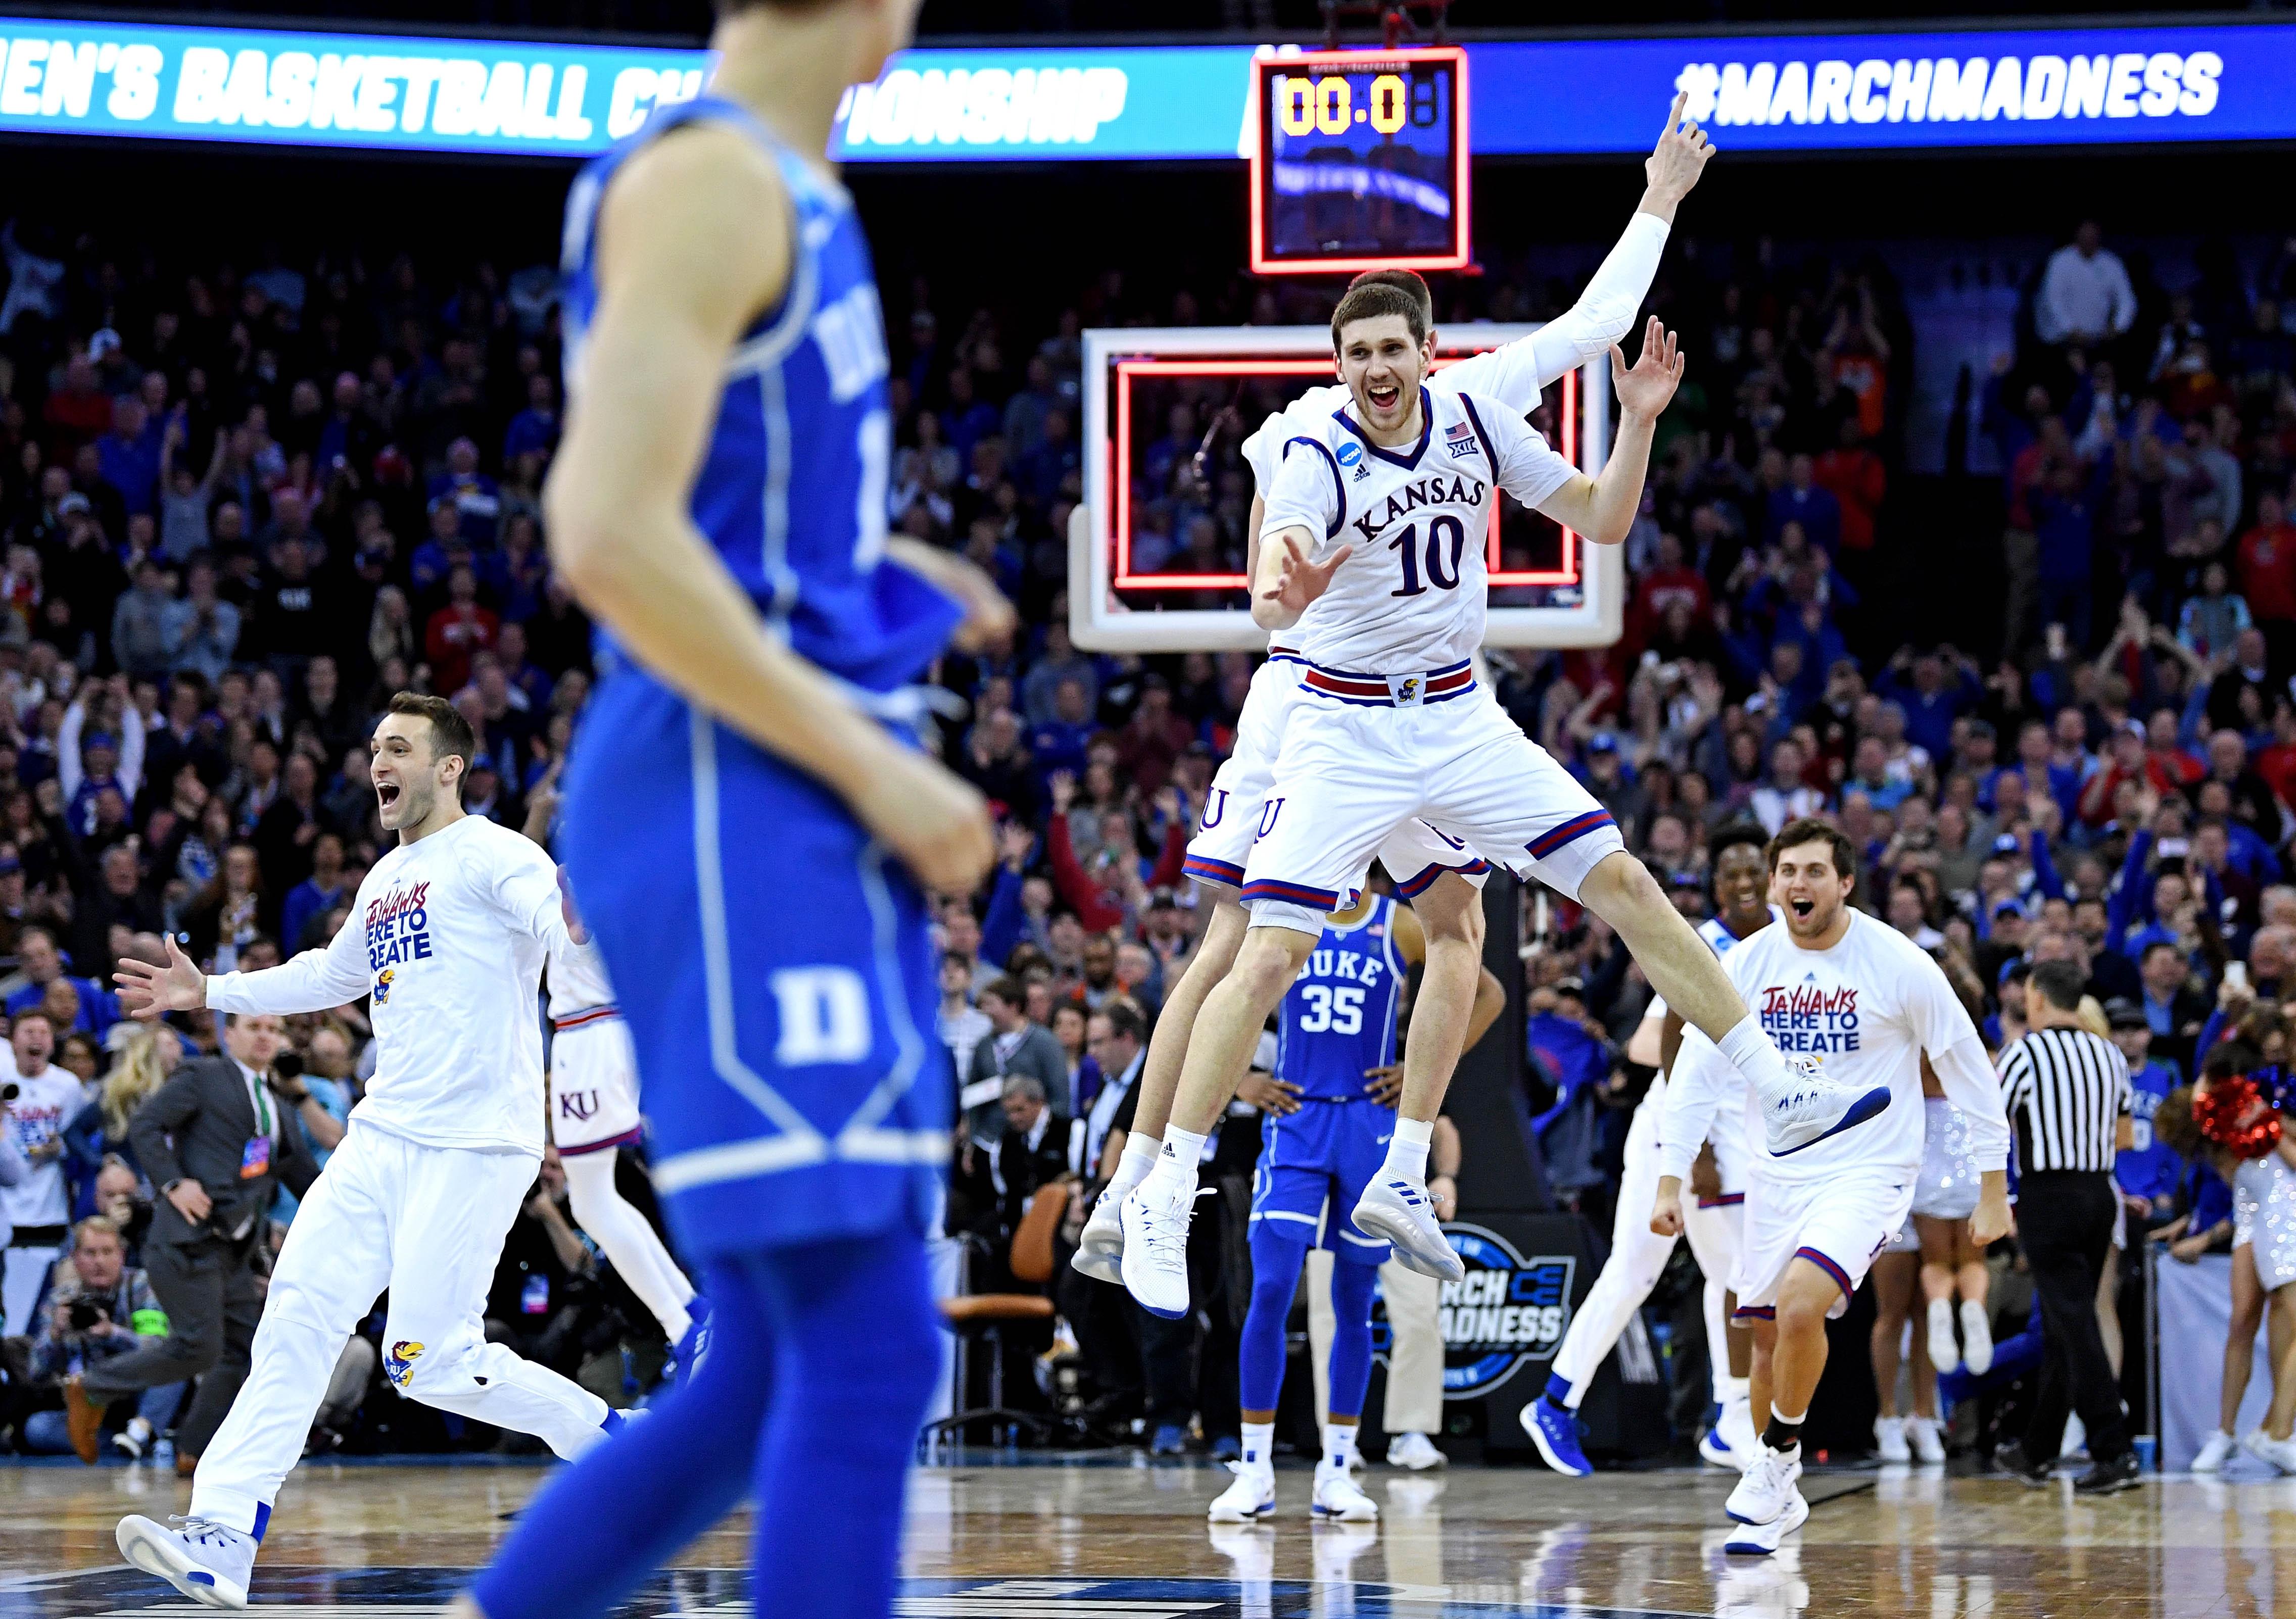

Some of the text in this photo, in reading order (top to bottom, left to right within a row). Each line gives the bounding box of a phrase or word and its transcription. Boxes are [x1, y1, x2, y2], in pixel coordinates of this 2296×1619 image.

[0, 38, 163, 120] EN'S
[174, 46, 592, 141] BASKETBALL
[1281, 75, 1406, 136] 00.0
[1673, 52, 2223, 126] #MARCHMADNESS
[1341, 448, 1361, 464] NCAA
[1353, 472, 1370, 482] adidas
[1353, 476, 1485, 543] KANSAS
[1389, 515, 1464, 597] 10
[1199, 787, 1229, 832] U
[1254, 798, 1285, 844] U
[366, 908, 427, 948] ERE TO
[369, 932, 433, 973] REATE
[769, 964, 872, 1066] D
[1300, 985, 1366, 1035] 35
[1761, 1010, 1858, 1030] HERE TO
[1763, 985, 1858, 1017] JAYHAWKS
[560, 1090, 598, 1121] KU
[1162, 1149, 1176, 1158] didas
[1440, 1269, 1510, 1306] RCH
[1439, 1305, 1563, 1344] ADNESS
